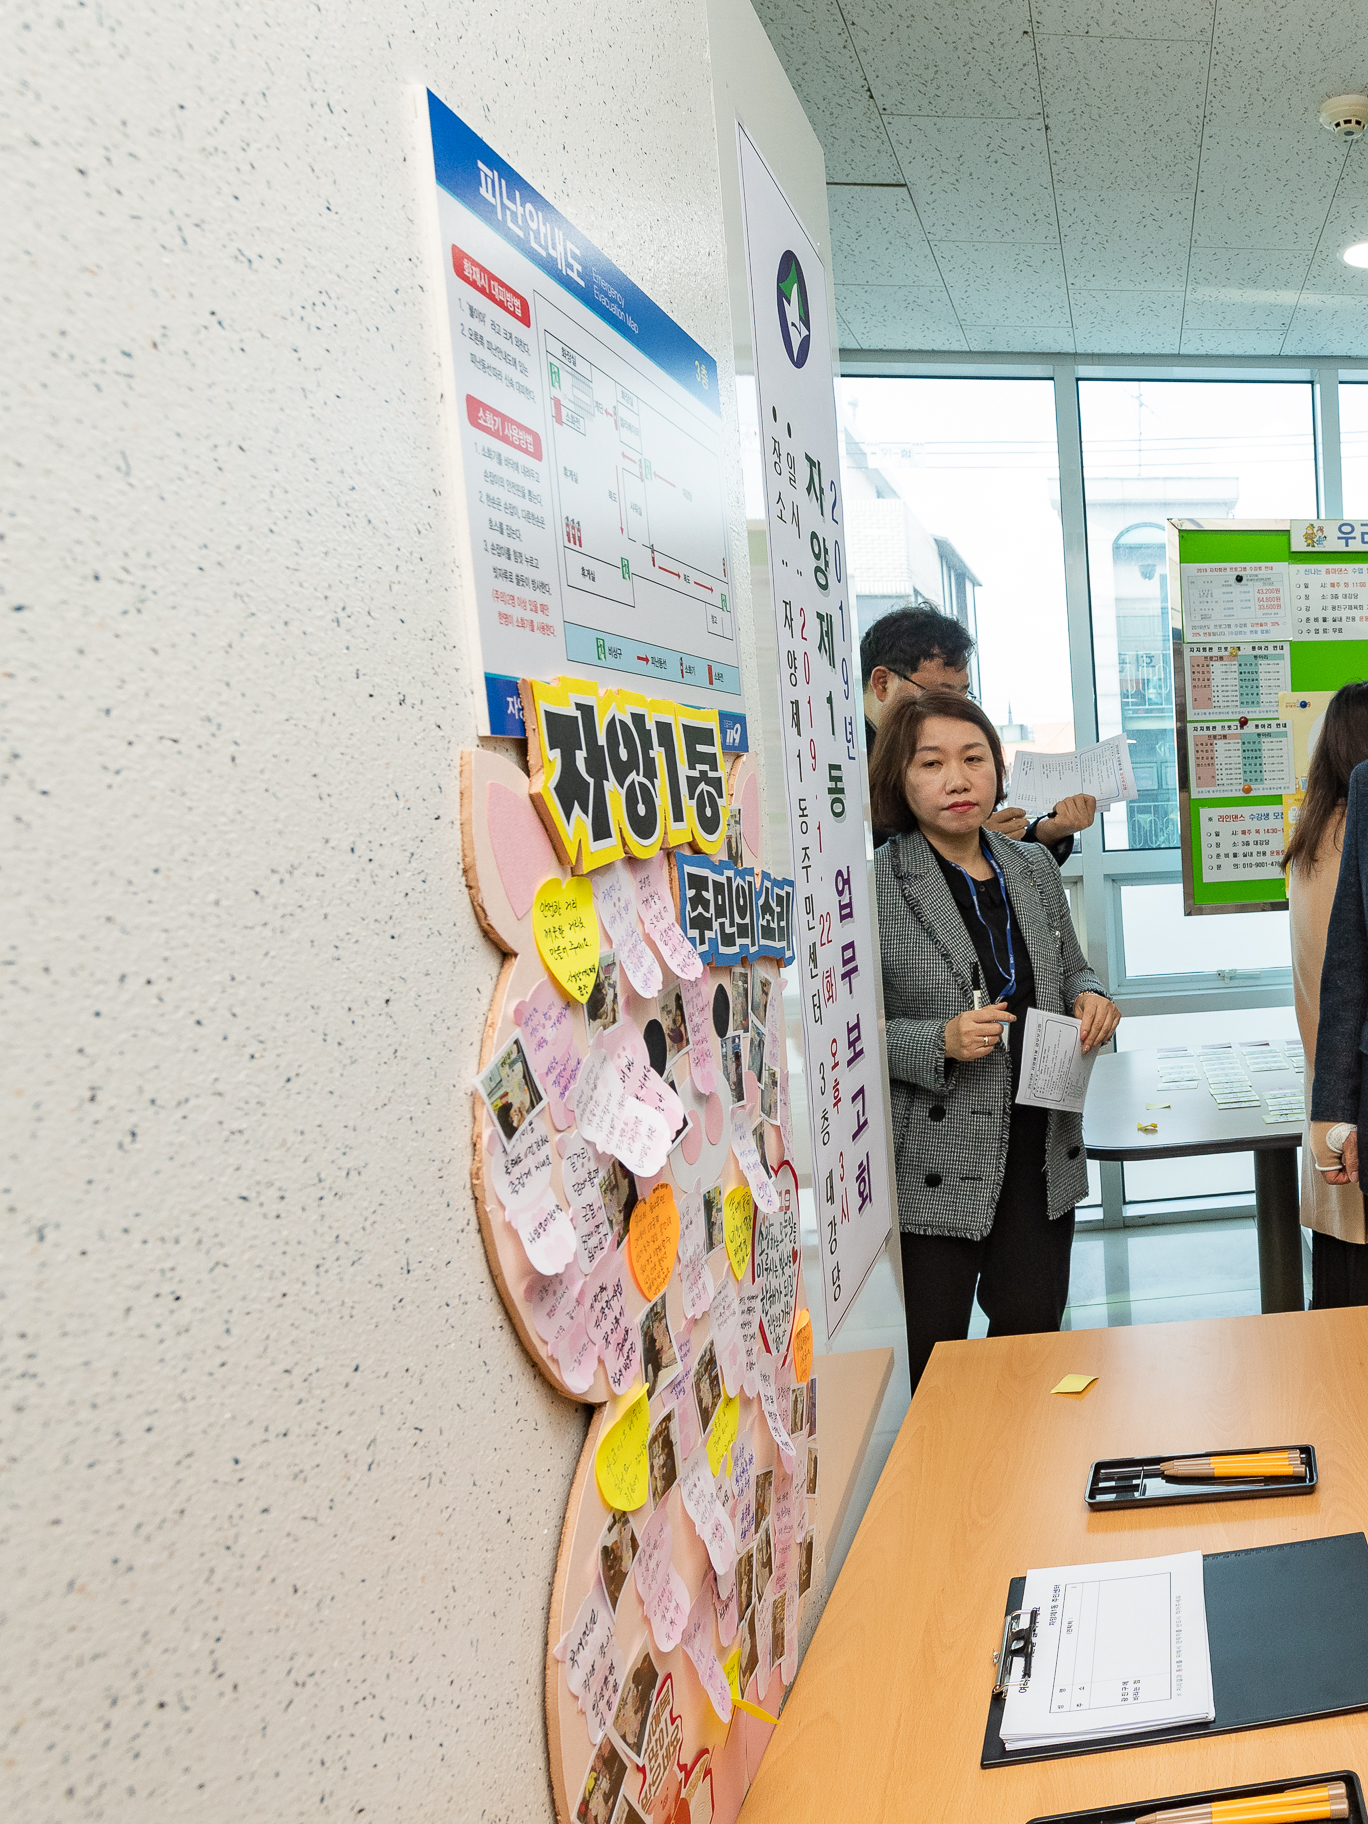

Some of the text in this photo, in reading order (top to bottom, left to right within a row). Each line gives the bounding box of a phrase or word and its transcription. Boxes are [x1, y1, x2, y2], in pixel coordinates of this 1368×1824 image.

[477, 160, 585, 288] 피난안내도
[463, 258, 522, 317] 화재시 대피방법
[592, 267, 625, 308] Emergency
[459, 298, 464, 311] 1.
[593, 285, 639, 334] Evacuation Map
[460, 322, 467, 337] 2.
[561, 346, 578, 368] 화장실
[694, 360, 709, 390] 3층
[477, 407, 534, 452] 소화기 사용방법
[581, 566, 596, 582] 휴게실
[516, 616, 535, 632] 소화기를
[830, 479, 856, 761] 2019년
[608, 646, 622, 660] 비상구
[684, 664, 696, 676] 소화기
[726, 723, 742, 747] 119
[543, 700, 725, 842] 자양1동
[1218, 814, 1246, 823] 라인댄스
[1249, 812, 1270, 821] 수강생
[804, 451, 873, 1216] 자양제1동 업무보고회
[686, 871, 757, 953] 주민의
[759, 884, 792, 959] 소리
[830, 1038, 842, 1114] 오후
[838, 1151, 850, 1225] 3시
[566, 1146, 588, 1173] 길거리
[508, 1166, 532, 1196] 즐겁게
[818, 1062, 830, 1146] 3층
[826, 1169, 842, 1302] 대강당
[756, 1252, 779, 1280] 이루시는
[761, 1279, 794, 1317] 한해가 되길
[1049, 1584, 1061, 1626] 자양제1동 주민센터
[1121, 1681, 1129, 1702] 광진구에
